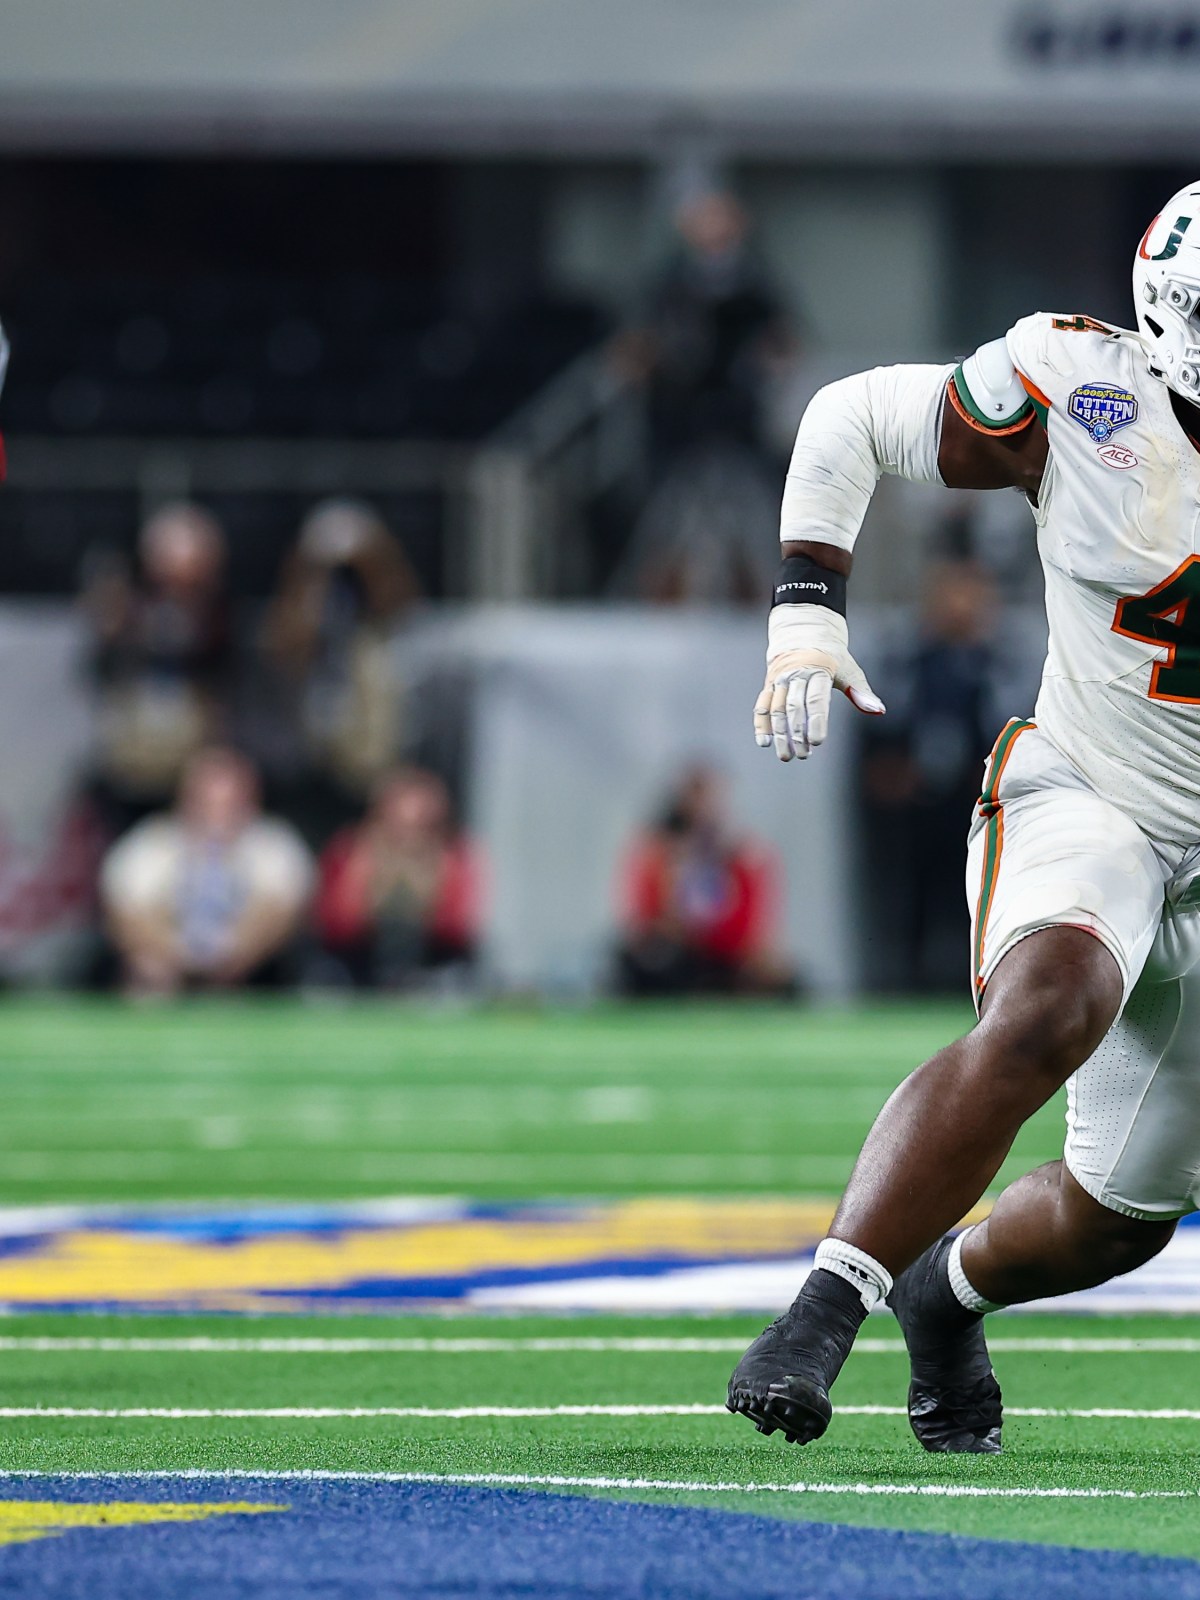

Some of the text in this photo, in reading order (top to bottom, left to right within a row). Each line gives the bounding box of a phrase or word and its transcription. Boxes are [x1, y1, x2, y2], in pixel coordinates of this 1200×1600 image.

[1139, 214, 1192, 260] U
[1076, 389, 1133, 400] GOODYEAR
[1073, 396, 1134, 420] COTTON
[1083, 408, 1122, 423] BOWL
[1103, 450, 1133, 462] ACC
[776, 582, 823, 594] MUELLER
